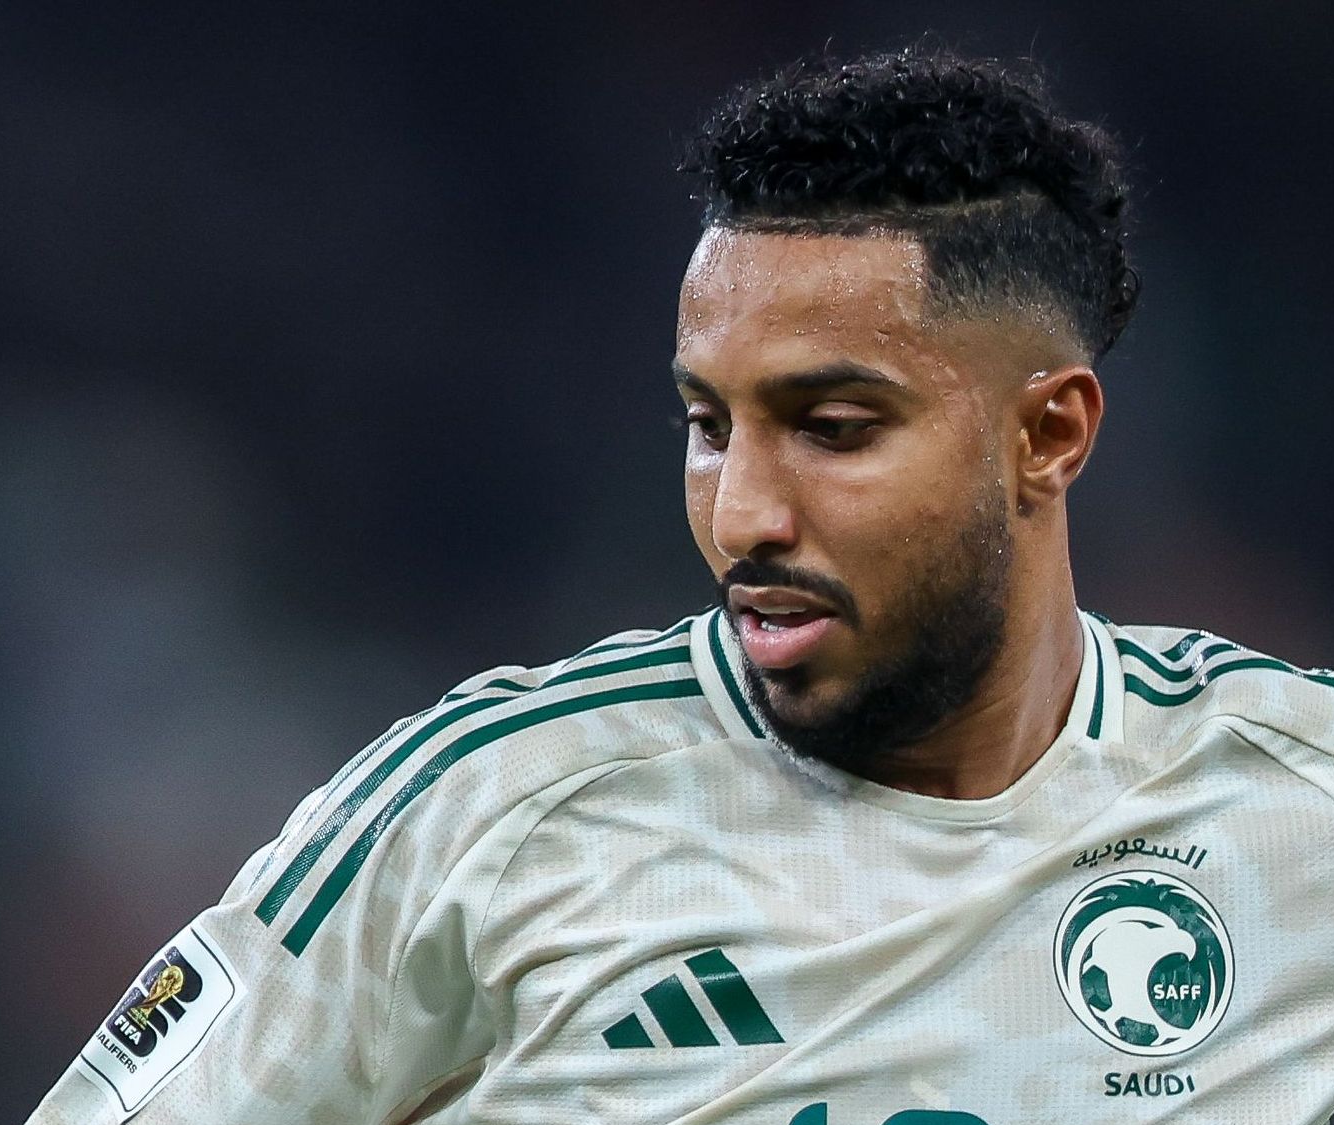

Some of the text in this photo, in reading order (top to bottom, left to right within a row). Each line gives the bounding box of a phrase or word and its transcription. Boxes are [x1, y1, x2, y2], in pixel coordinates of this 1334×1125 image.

[1072, 837, 1208, 869] السعودية
[1154, 983, 1202, 1001] SAFF
[114, 1015, 141, 1045] FIFA
[96, 1031, 137, 1073] ALIFIERS
[1104, 1072, 1195, 1097] SAUDI
